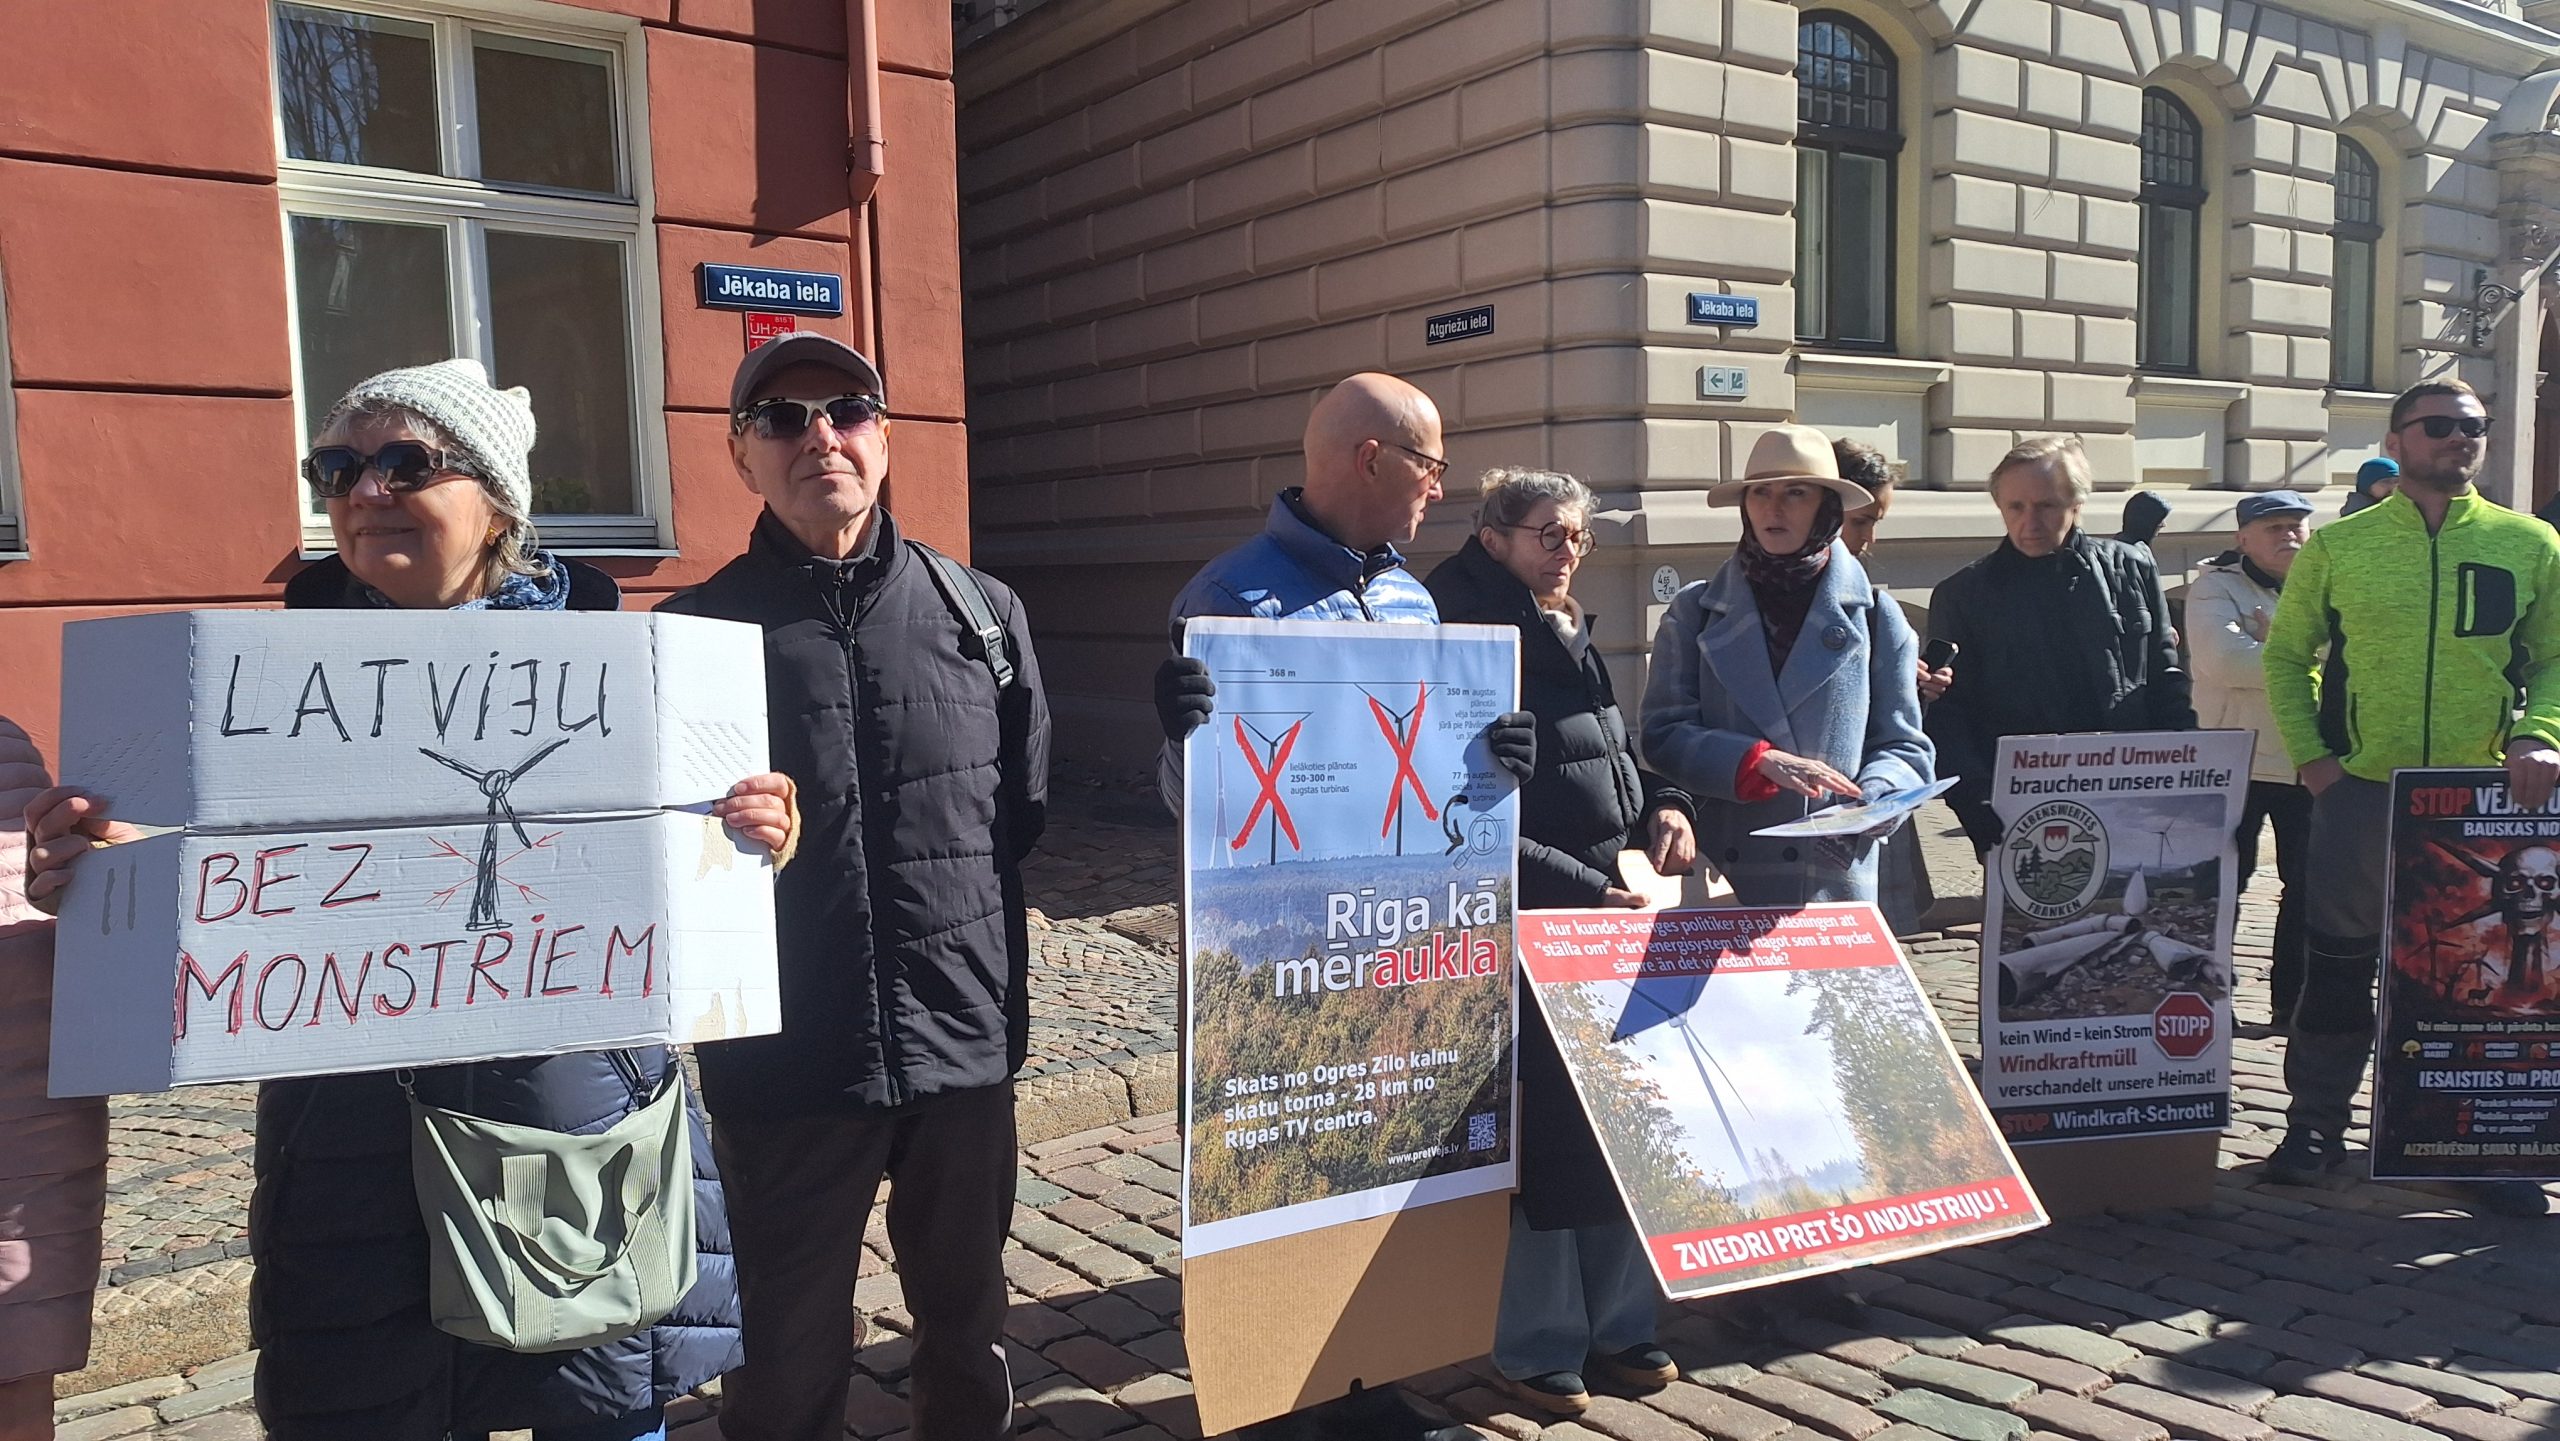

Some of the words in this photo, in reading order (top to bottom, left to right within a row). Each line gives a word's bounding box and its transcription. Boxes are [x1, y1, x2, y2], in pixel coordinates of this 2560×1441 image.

[719, 274, 791, 300] Jēkaba
[796, 281, 831, 303] iela
[1698, 300, 1734, 317] Jēkaba
[1735, 303, 1754, 318] iela
[749, 322, 770, 335] UH
[1429, 317, 1468, 338] Atgriežu
[1470, 313, 1488, 330] iela
[1269, 668, 1286, 677] 368
[1446, 687, 1461, 696] 350
[1289, 762, 1326, 772] lielākoties
[1327, 761, 1358, 772] plānotas
[2013, 749, 2072, 770] Natur
[2077, 746, 2115, 767] und
[2121, 743, 2198, 766] Umwelt
[1290, 773, 1325, 783] 250-300
[1451, 771, 1462, 780] 77
[2009, 773, 2104, 796] brauchen
[2108, 772, 2175, 792] unsere
[2179, 768, 2233, 789] Hilfe!
[1290, 786, 1319, 797] augstas
[2410, 786, 2472, 816] STOP
[2016, 803, 2098, 835] LEBENSWERTES
[2463, 820, 2535, 837] BAUSKAS
[194, 841, 382, 924] BEZ
[1325, 888, 1431, 948] Rīga
[1448, 878, 1498, 929] kā
[2027, 899, 2082, 918] FRANKEN
[1542, 920, 1572, 937] Hur
[1572, 918, 1620, 936] kunde
[1619, 917, 1679, 937] Sveriges
[1681, 913, 1736, 935] politiker
[1737, 913, 1754, 934] gå
[1757, 913, 1773, 932] på
[1773, 912, 1839, 932] blåsningen
[1840, 913, 1860, 927] att
[1614, 937, 1647, 955] vårt
[1647, 936, 1733, 956] energisystem
[1733, 933, 1753, 950] till
[1753, 934, 1792, 952] något
[1791, 934, 1818, 947] som
[1818, 932, 1832, 947] är
[1833, 930, 1877, 949] mycket
[1274, 929, 1499, 999] mēraukla
[1612, 957, 1657, 975] sämre
[1657, 956, 1676, 972] än
[1678, 954, 1702, 971] det
[1702, 954, 1715, 970] vi
[1716, 952, 1752, 969] redan
[1754, 951, 1791, 968] hade?
[172, 913, 657, 1046] MONSTRIEM
[2000, 1029, 2030, 1047] kein
[2033, 1027, 2072, 1045] Wind
[2074, 1030, 2082, 1040] =
[2084, 1025, 2112, 1041] kein
[2114, 1025, 2153, 1040] Strom
[2158, 1014, 2211, 1038] STOPP
[1224, 1074, 1279, 1099] Skats
[1284, 1069, 1308, 1090] no
[1313, 1060, 1368, 1086] Ogres
[1371, 1054, 1405, 1076] Zilo
[1409, 1048, 1459, 1070] kalnu
[2000, 1047, 2138, 1074] Windkraftmüll
[1999, 1076, 2104, 1098] verschandelt
[2107, 1075, 2155, 1092] unsere
[2158, 1068, 2217, 1088] Heimat!
[2418, 1070, 2505, 1089] IESAISTIES
[2507, 1072, 2528, 1086] UN
[1224, 1098, 1279, 1124] skatu
[1285, 1093, 1335, 1114] torņa
[1354, 1082, 1376, 1102] 28
[1381, 1080, 1408, 1098] km
[1413, 1074, 1435, 1092] no
[1224, 1125, 1280, 1150] Rīgas
[1284, 1116, 1309, 1139] TV
[1313, 1109, 1379, 1134] centra.
[2000, 1112, 2050, 1135] STOP
[2052, 1101, 2216, 1131] Windkraft-Schrott!
[1672, 1231, 1773, 1272] ZVIEDRI
[1771, 1217, 1833, 1253] PRET
[1826, 1210, 1865, 1243] ŠO
[1862, 1191, 1996, 1237] INDUSTRIJU
